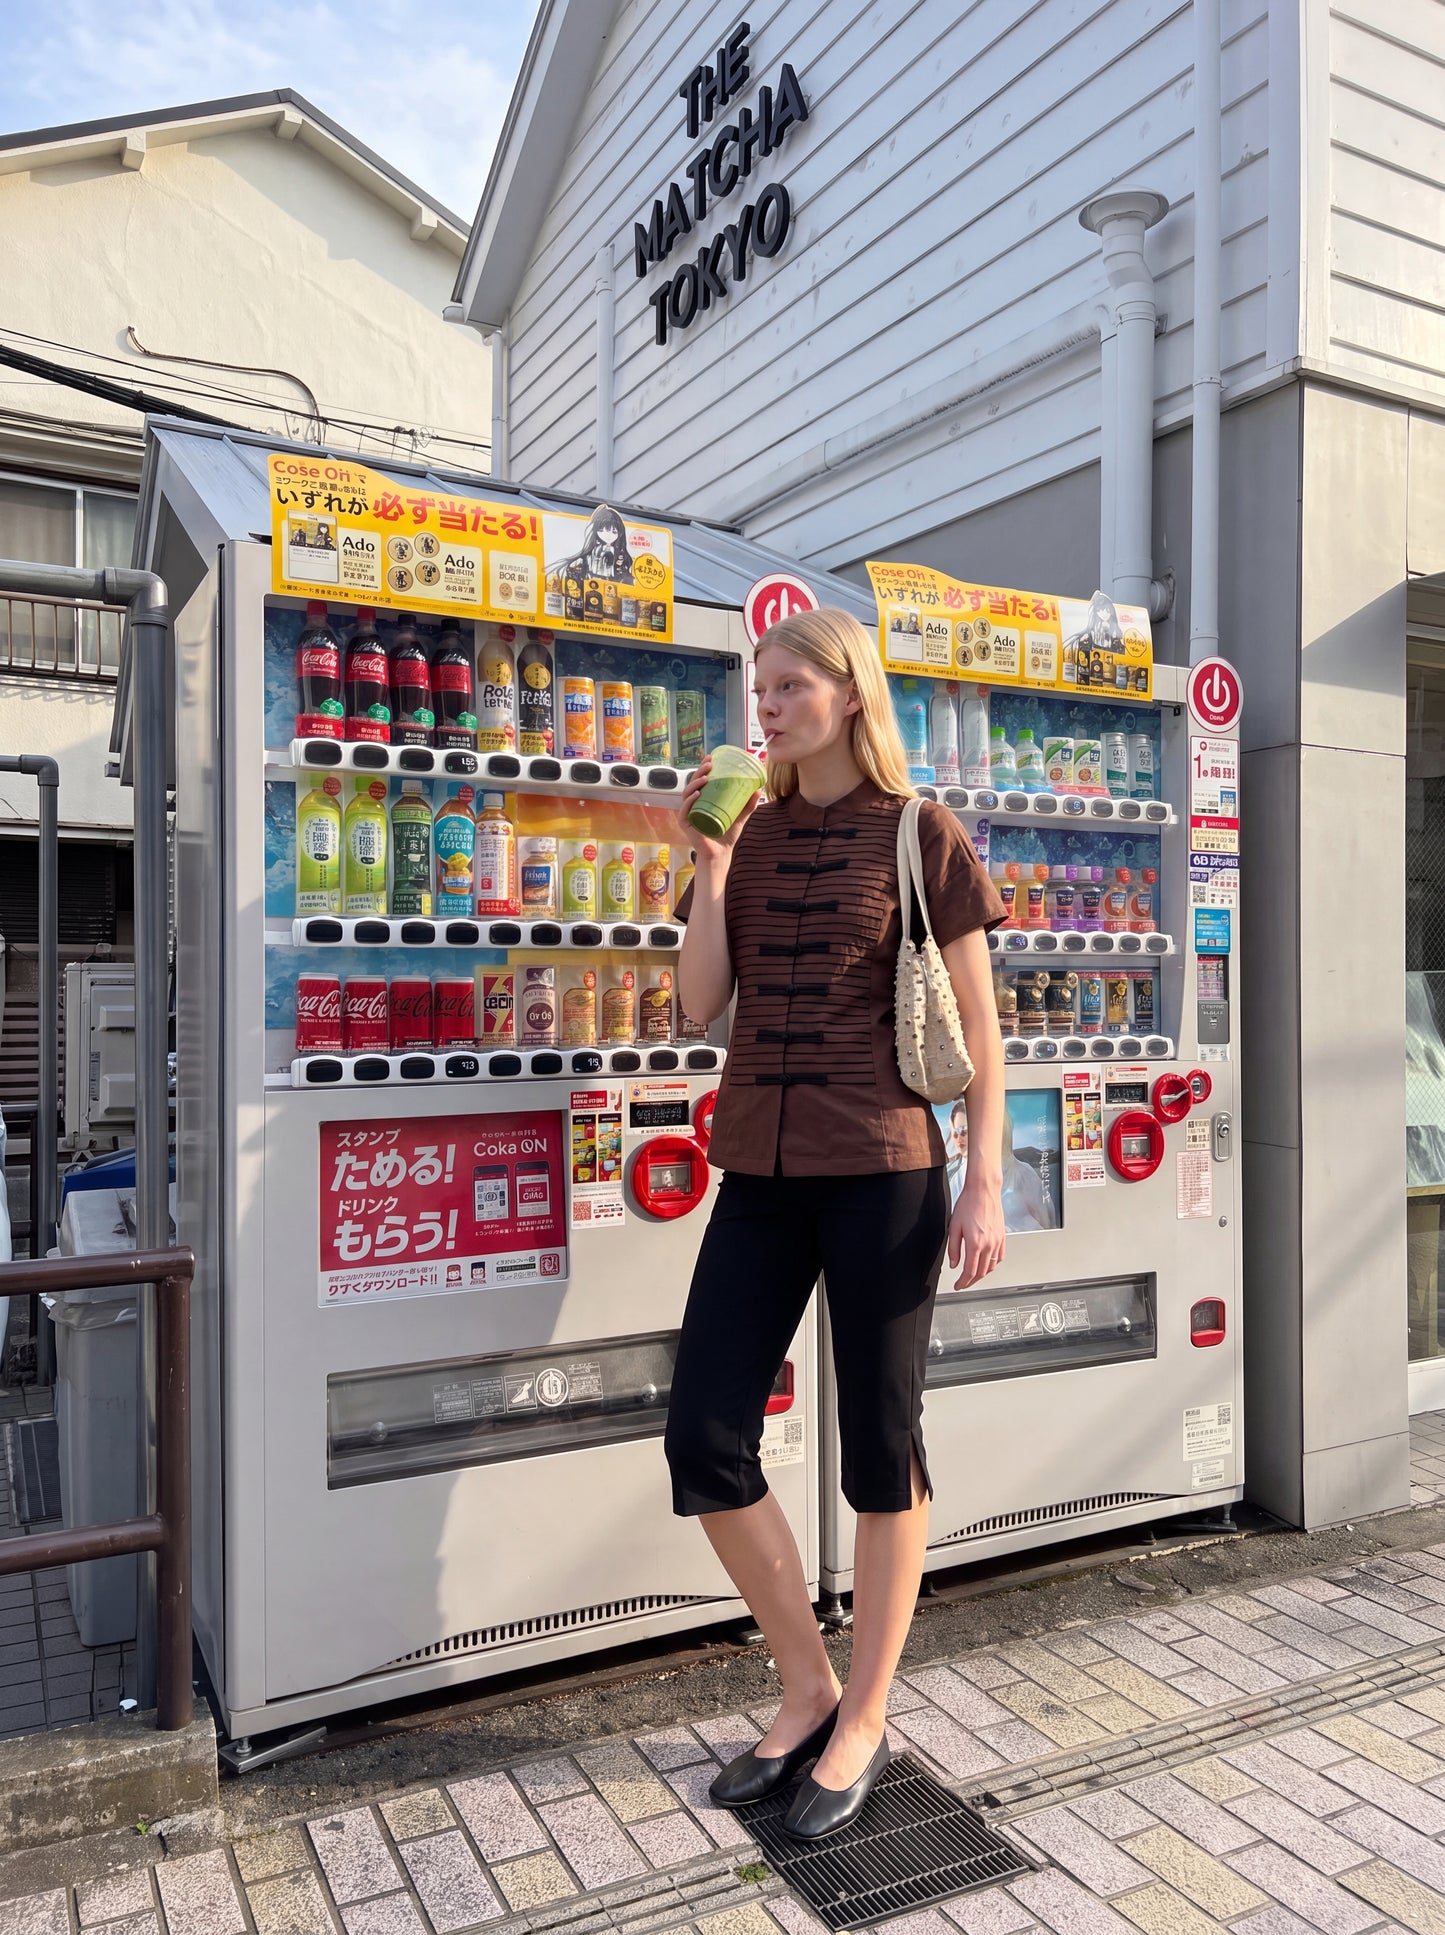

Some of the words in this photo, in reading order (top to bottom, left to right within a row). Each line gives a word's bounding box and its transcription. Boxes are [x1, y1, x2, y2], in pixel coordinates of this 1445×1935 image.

[680, 21, 751, 139] THE
[634, 62, 809, 279] MATCHA
[648, 182, 791, 346] TOKYO
[275, 488, 370, 516] いずれが
[372, 491, 538, 542] 必ず当たる!
[342, 535, 375, 553] Ado
[444, 553, 475, 570] Ado
[877, 585, 941, 606] いずれが
[943, 586, 1058, 622] 必ず当たる!
[925, 621, 949, 636] Ado
[993, 634, 1016, 648] Ado
[336, 1128, 401, 1148] スタンプ
[473, 1141, 517, 1157] Coka
[519, 1138, 548, 1154] ON
[329, 1143, 456, 1193] ためる!
[337, 1195, 399, 1218] ドリンク
[332, 1208, 459, 1262] もらう!
